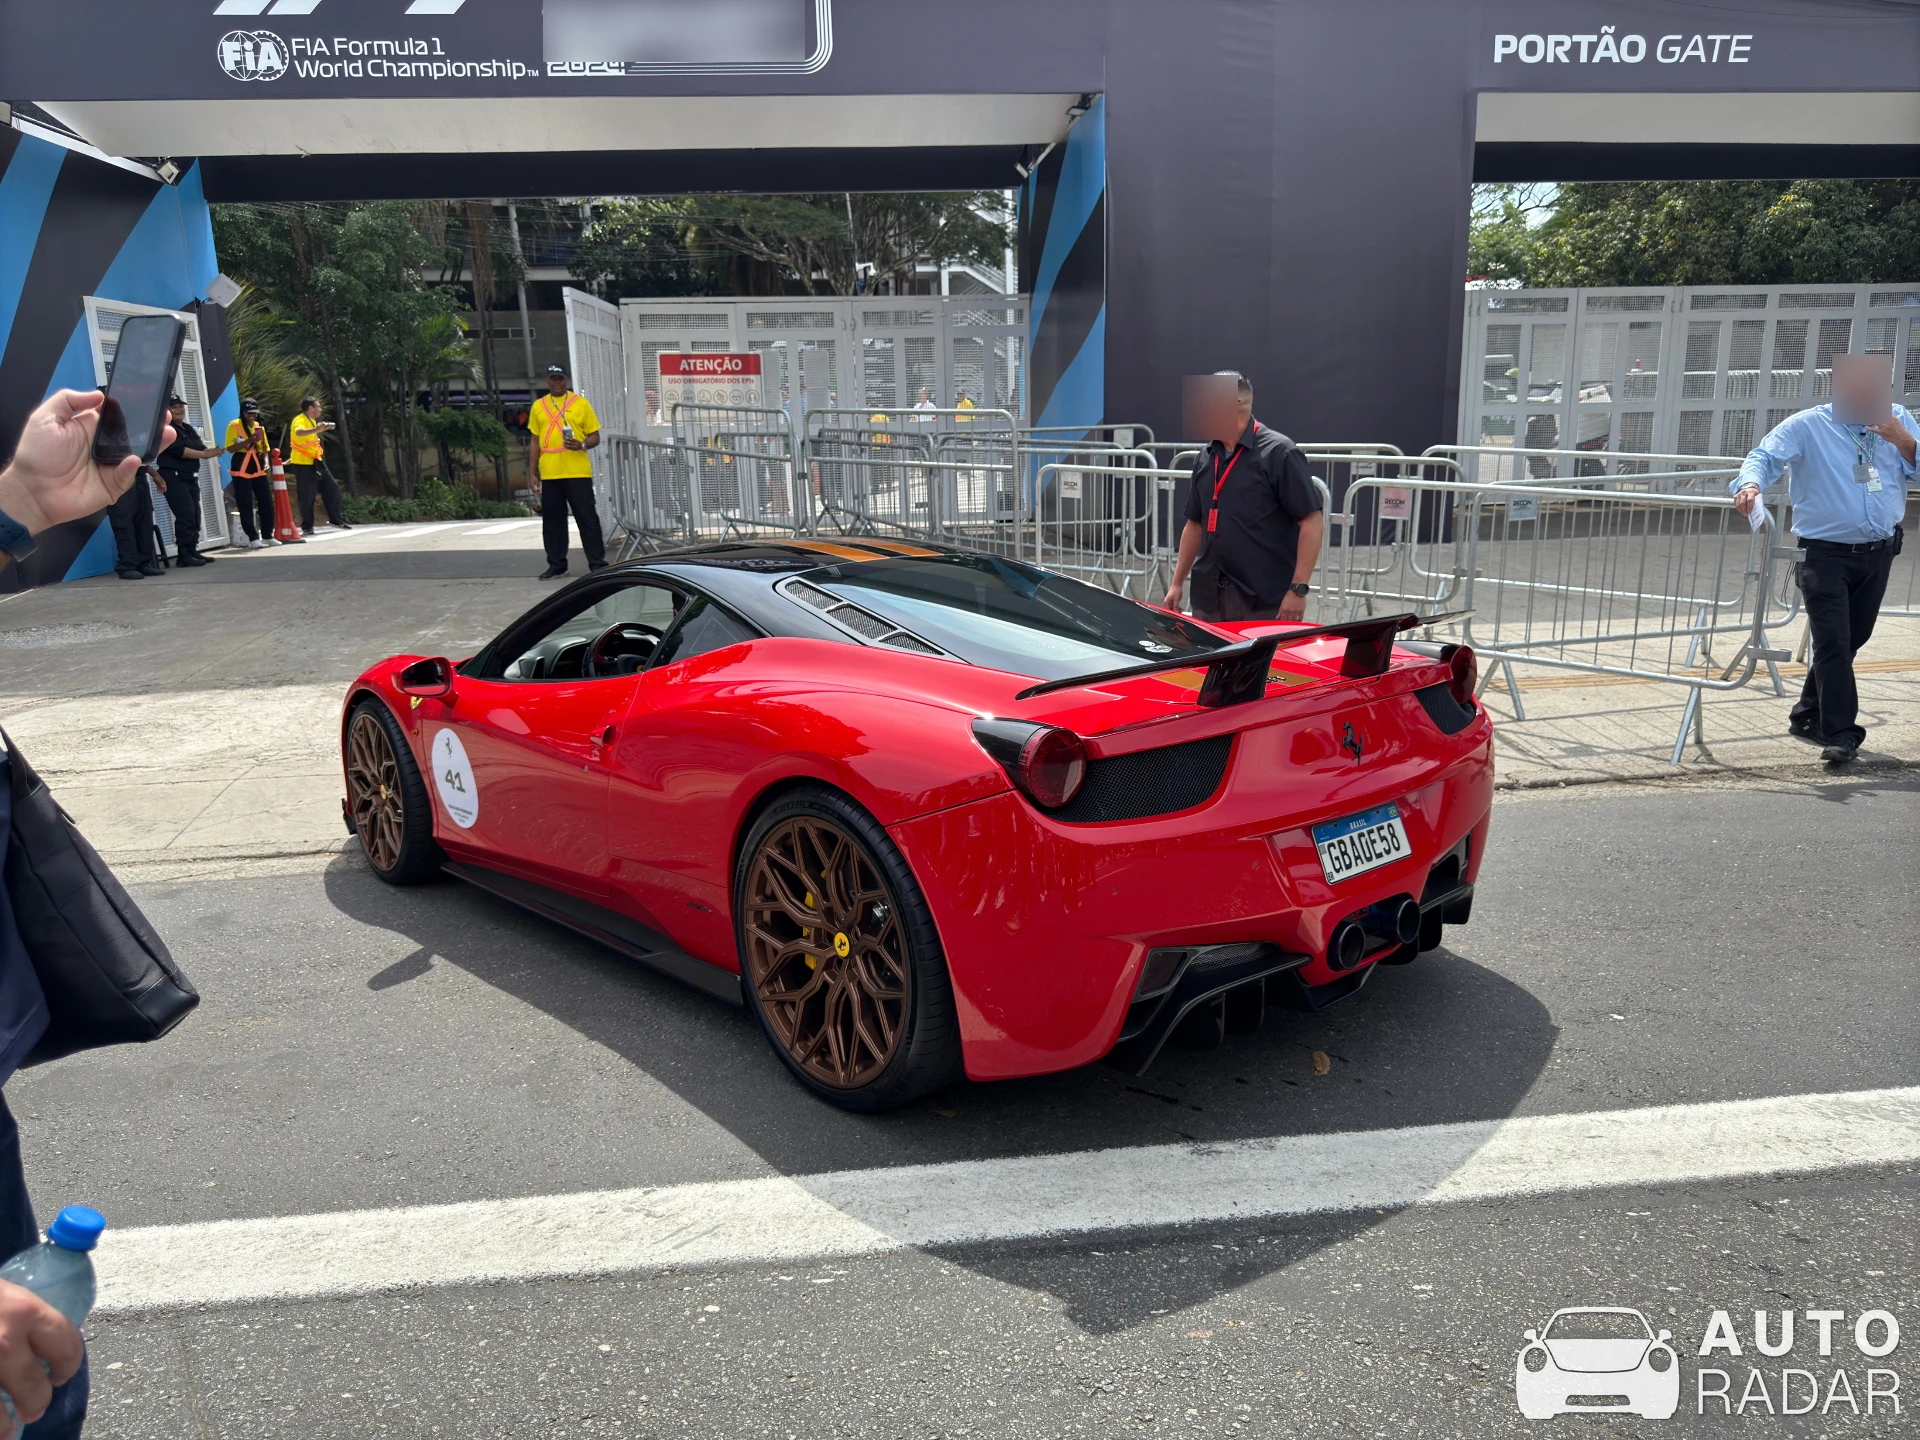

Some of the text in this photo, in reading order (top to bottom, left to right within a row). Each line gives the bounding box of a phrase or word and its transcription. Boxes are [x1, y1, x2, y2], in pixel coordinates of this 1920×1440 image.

[291, 37, 446, 56] FIA Formula 1
[1493, 25, 1754, 64] PORTÃO GATE
[294, 59, 363, 78] World
[679, 356, 743, 375] ATENÇÃO
[683, 376, 726, 385] OBRIGATÓRIO
[1384, 497, 1405, 506] RECON
[1512, 499, 1532, 507] RECON
[445, 769, 467, 794] 41
[1349, 818, 1367, 830] BRASIL
